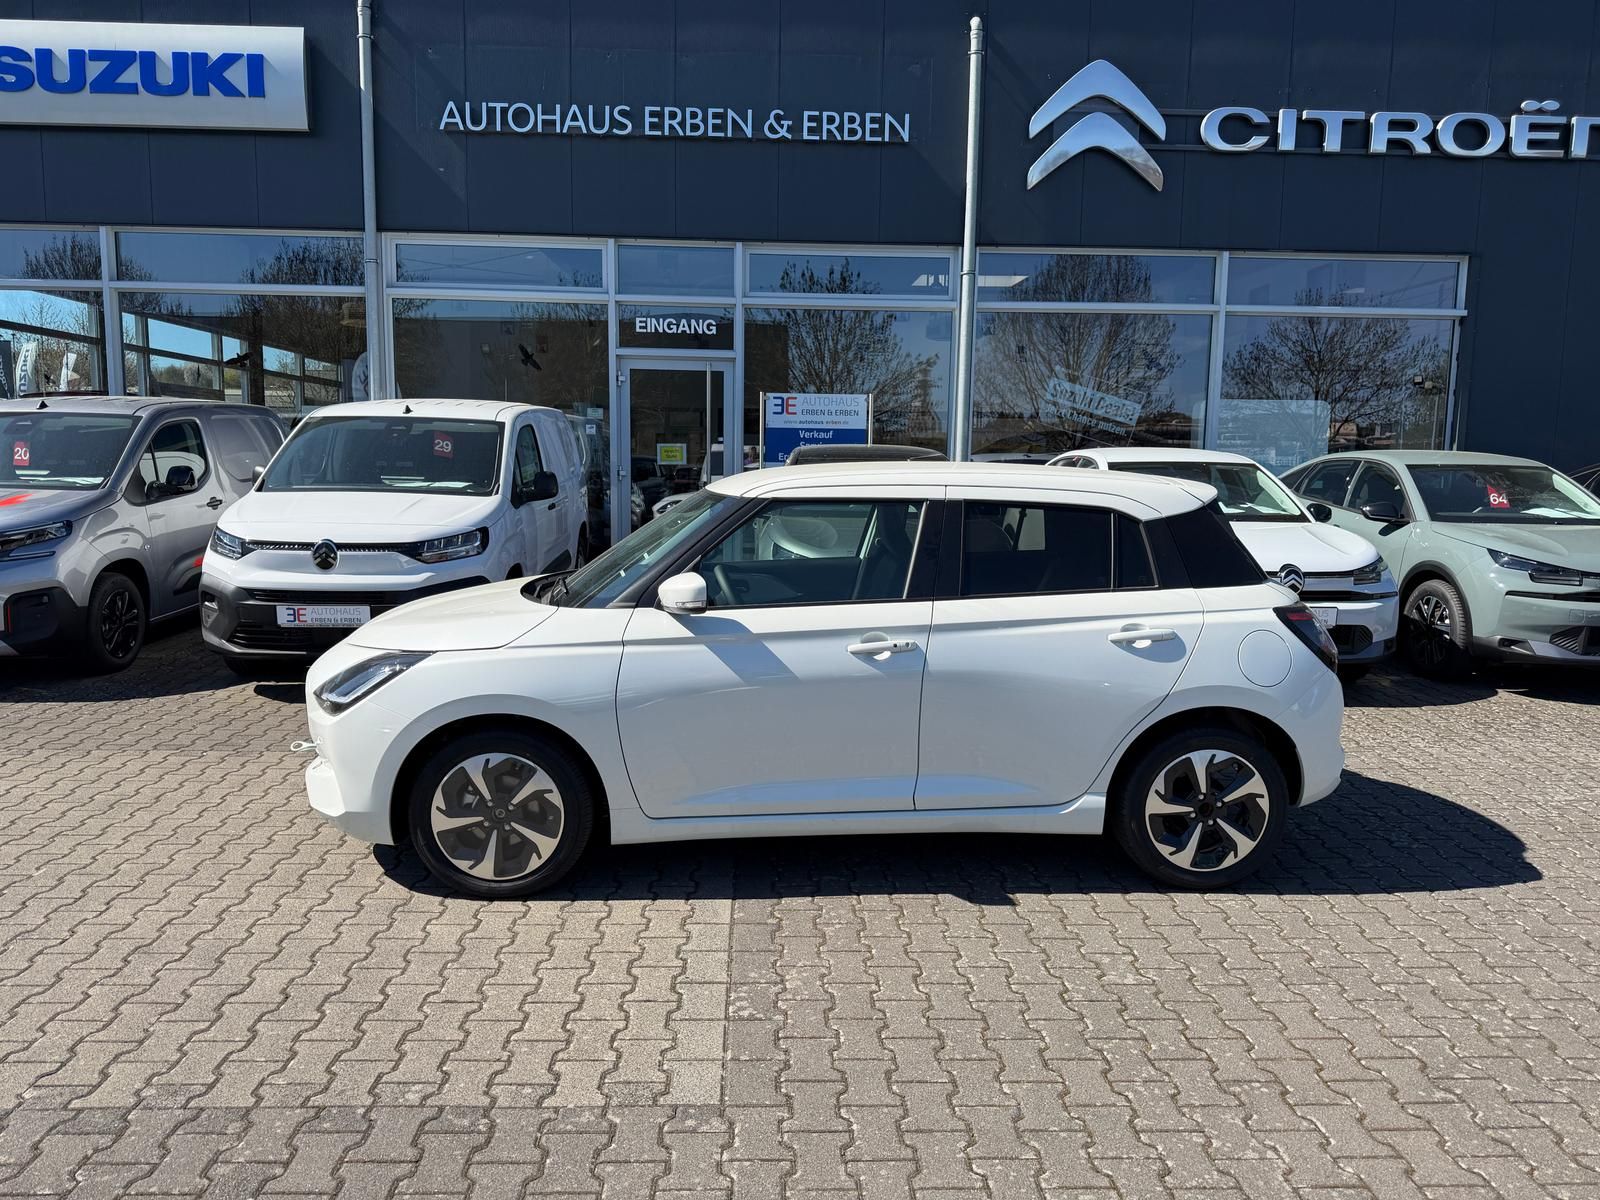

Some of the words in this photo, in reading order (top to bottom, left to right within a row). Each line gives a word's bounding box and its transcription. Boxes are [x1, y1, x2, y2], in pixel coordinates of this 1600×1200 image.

[0, 45, 265, 98] SUZUKI
[439, 101, 632, 135] AUTOHAUS
[644, 106, 752, 138] ERBEN
[764, 109, 792, 139] &
[803, 110, 910, 142] ERBEN
[635, 317, 717, 335] EINGANG
[801, 397, 859, 407] AUTOHAUS
[835, 409, 859, 417] ERBEN
[799, 430, 834, 439] Verkauf
[434, 439, 452, 453] 29
[14, 447, 30, 460] 20
[1490, 493, 1508, 505] 64
[310, 607, 361, 616] AUTOHAUS
